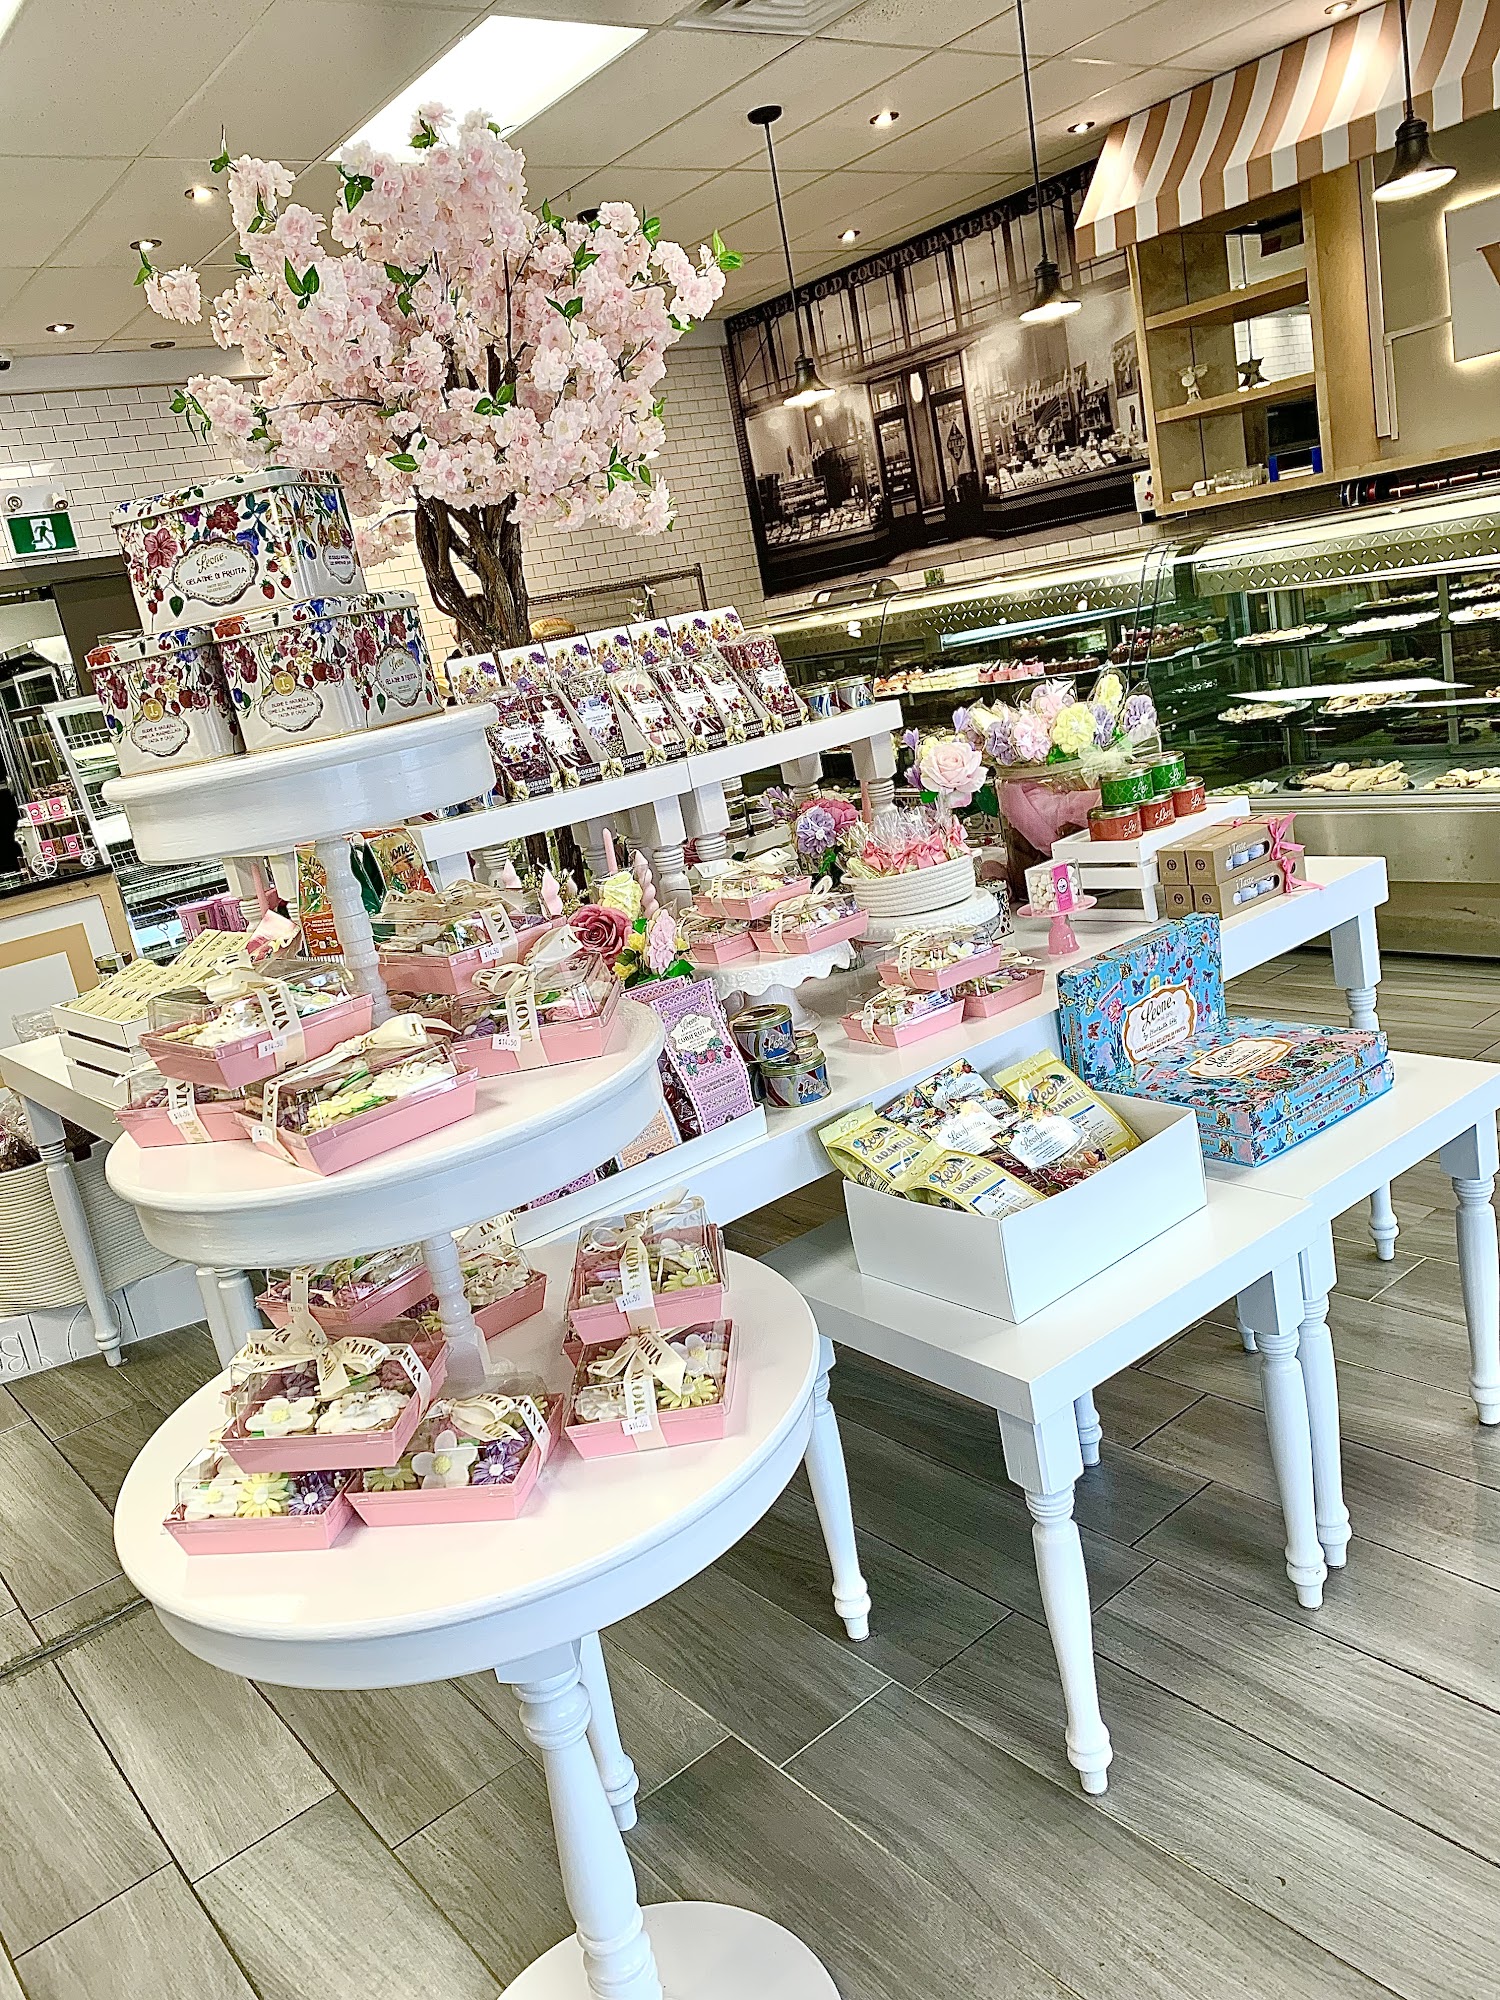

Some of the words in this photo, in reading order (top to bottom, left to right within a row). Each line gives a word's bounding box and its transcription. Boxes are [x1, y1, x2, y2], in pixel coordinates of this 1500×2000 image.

[814, 277, 843, 299] OLD
[848, 246, 920, 284] COUNTRY
[927, 206, 1012, 249] BAKERY
[1239, 876, 1255, 889] Taste
[1141, 996, 1175, 1032] Leone
[498, 1038, 518, 1047] $14.50
[853, 1126, 896, 1156] Leone
[872, 1136, 917, 1164] CARAMELLE
[928, 1157, 970, 1189] Leone
[952, 1166, 996, 1195] CARAMELLE
